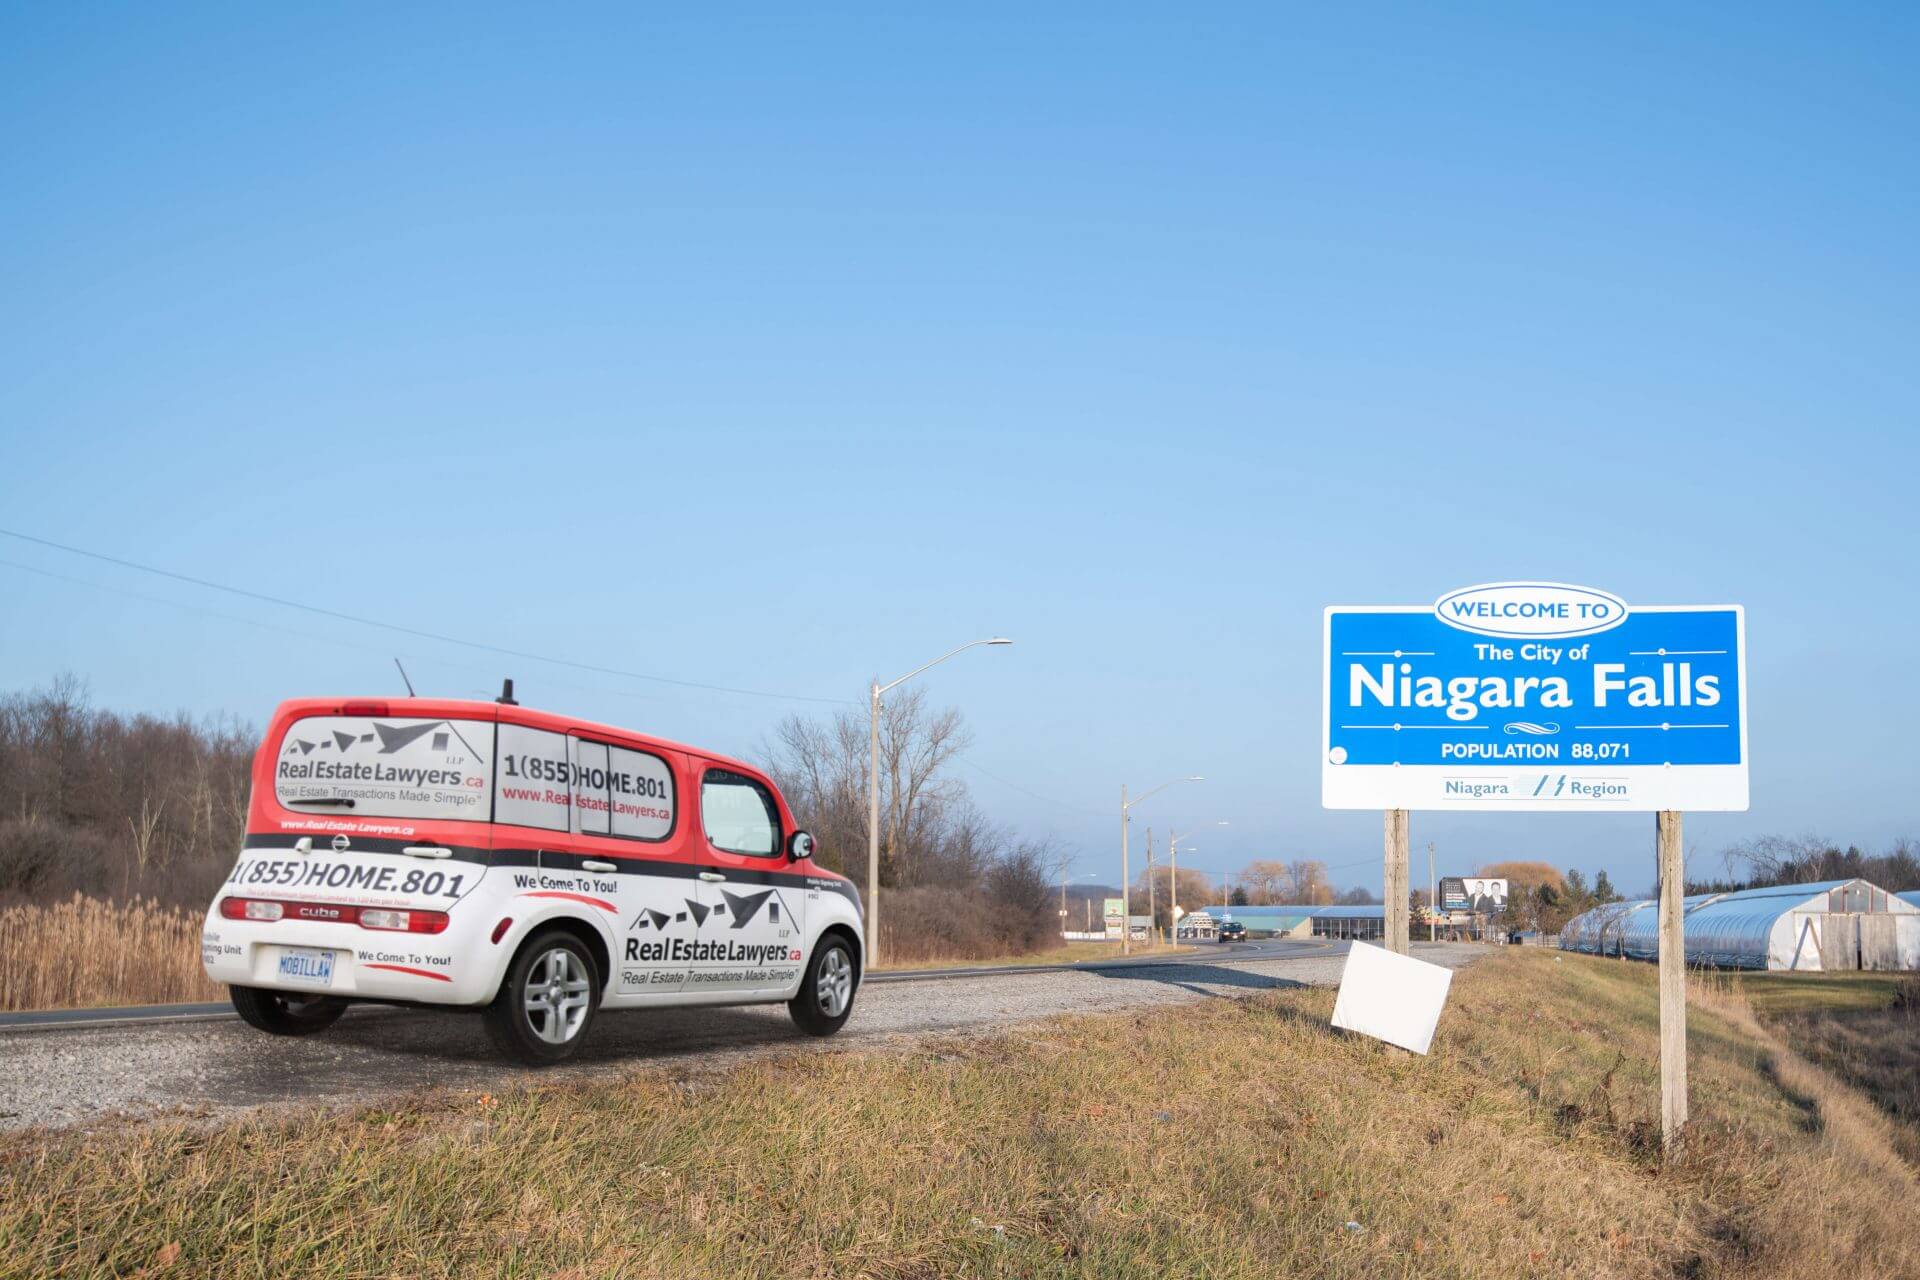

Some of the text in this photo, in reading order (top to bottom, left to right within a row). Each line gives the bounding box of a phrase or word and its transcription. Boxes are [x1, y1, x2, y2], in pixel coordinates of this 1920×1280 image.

[1451, 601, 1610, 619] WELCOME TO
[1474, 643, 1590, 665] The City of
[1349, 662, 1721, 721] Niagara Falls
[1441, 743, 1631, 760] POPULATION 88,071
[332, 787, 396, 800] Transactions
[400, 790, 431, 802] Made
[1445, 780, 1628, 797] Niagara Region
[514, 874, 617, 893] We Come To You!
[300, 907, 340, 918] cube
[224, 943, 242, 955] Unit
[358, 950, 452, 966] We Come To You!
[650, 971, 684, 984] Estate
[687, 970, 743, 984] Transactions
[743, 970, 767, 981] Made
